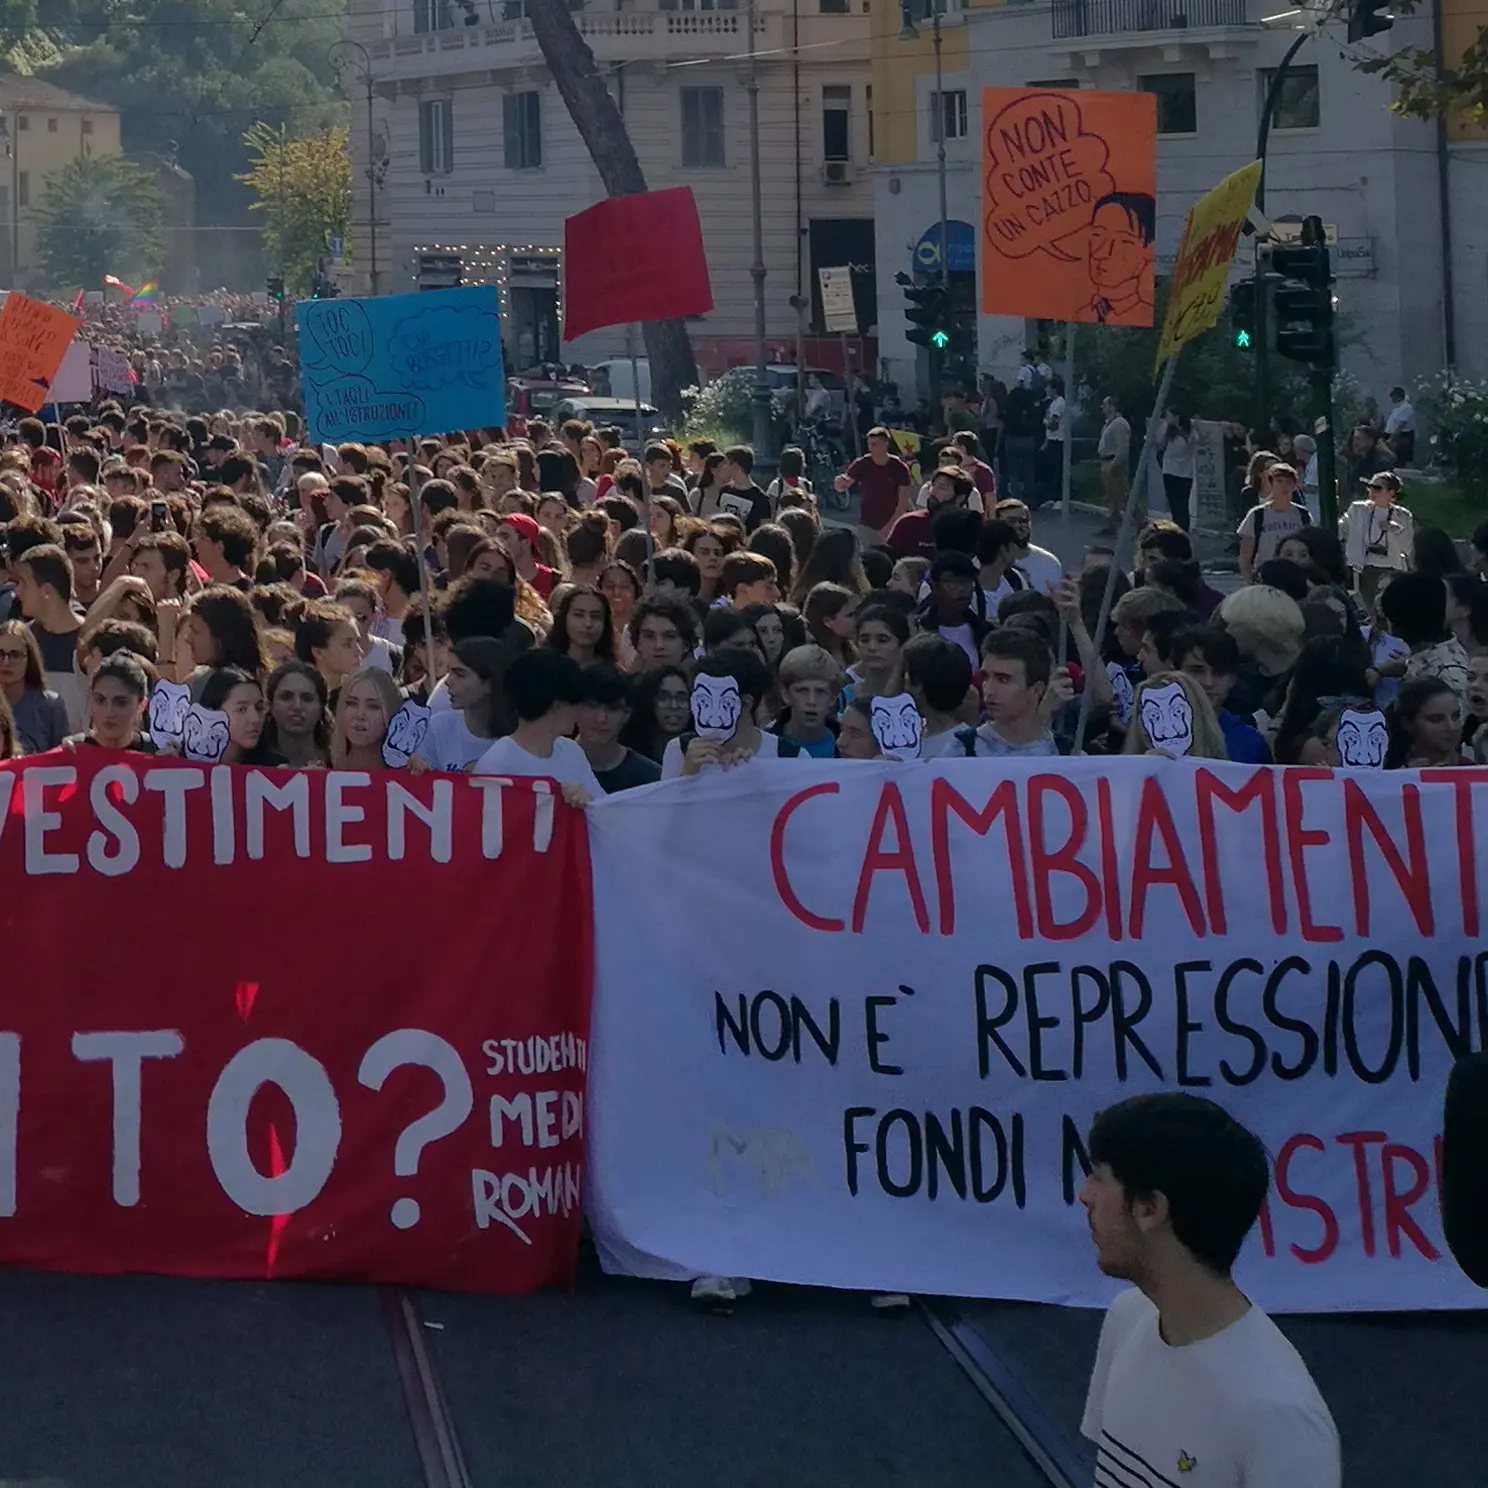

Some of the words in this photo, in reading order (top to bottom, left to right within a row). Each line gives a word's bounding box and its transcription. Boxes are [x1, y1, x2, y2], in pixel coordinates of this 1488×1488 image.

[1000, 105, 1067, 163] NON
[1002, 149, 1082, 199] CONTE
[994, 215, 1026, 241] UN
[1025, 179, 1091, 226] CAZZO
[316, 307, 349, 337] TOC
[325, 330, 365, 361] TOC!
[714, 989, 841, 1066] NON
[489, 1089, 584, 1149] MEDI
[843, 1106, 1026, 1209] FONDI
